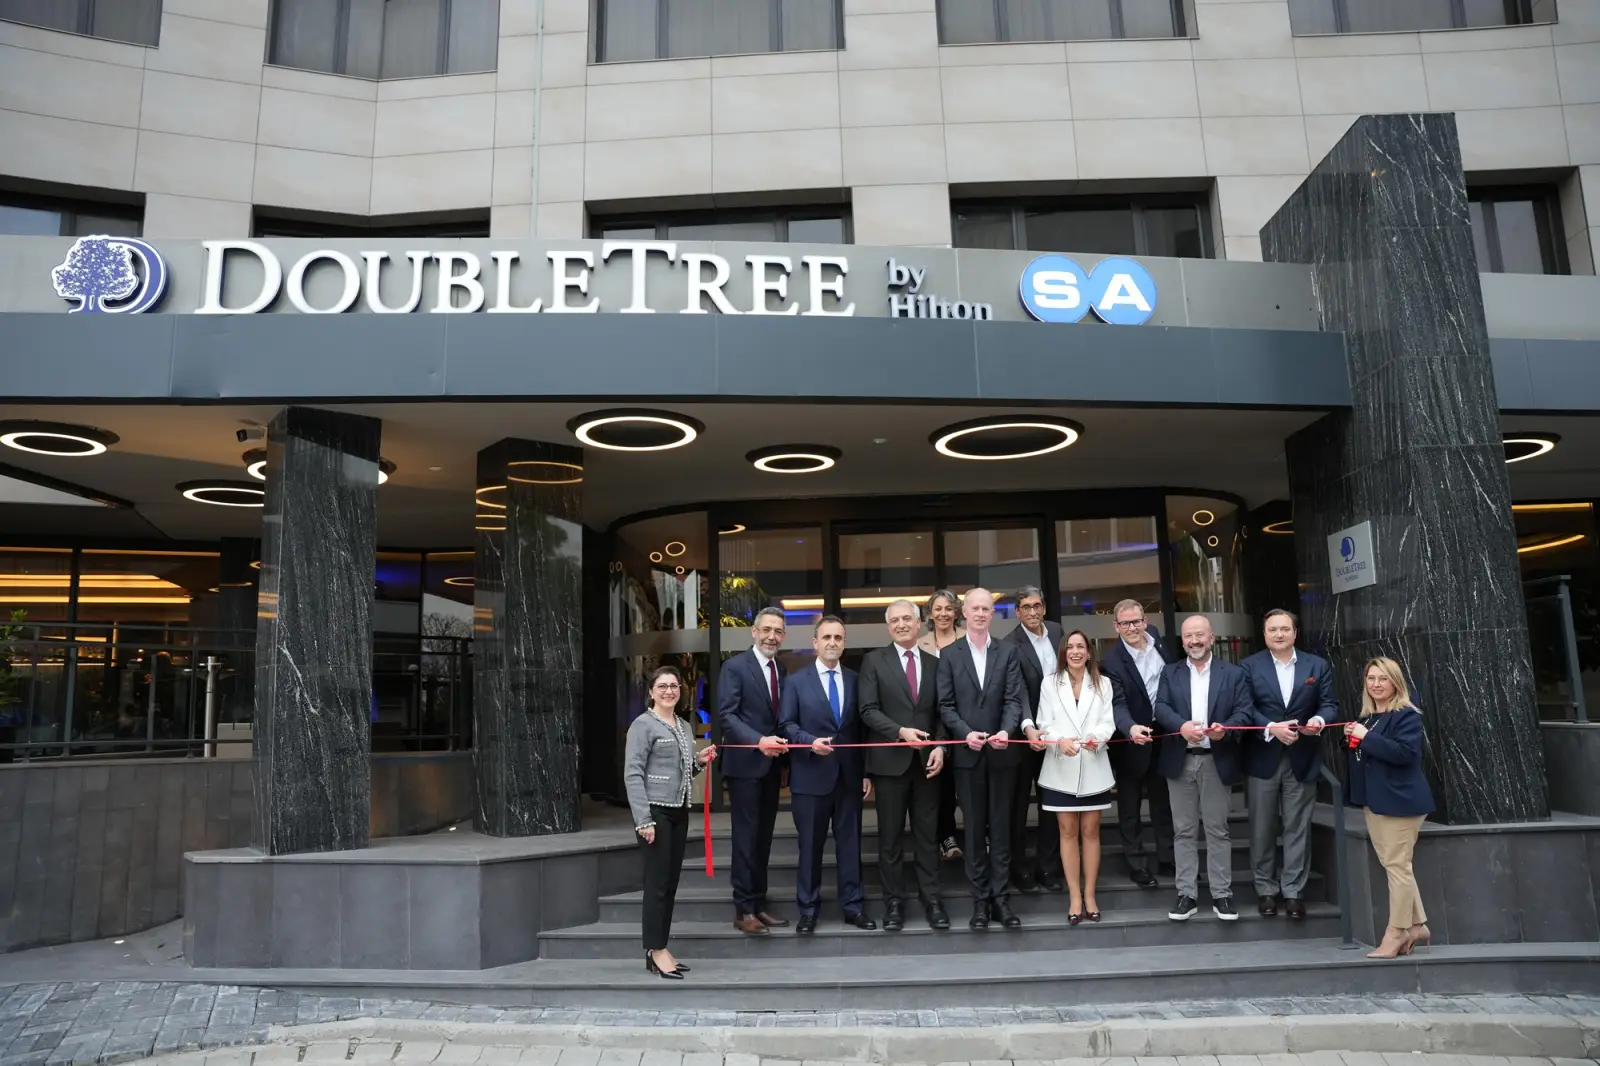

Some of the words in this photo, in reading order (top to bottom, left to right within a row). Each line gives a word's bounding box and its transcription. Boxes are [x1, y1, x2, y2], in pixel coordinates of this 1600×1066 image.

[194, 240, 856, 317] DOUBLETREE
[888, 257, 926, 293] by
[1032, 270, 1152, 312] SA
[889, 293, 993, 321] Hilton
